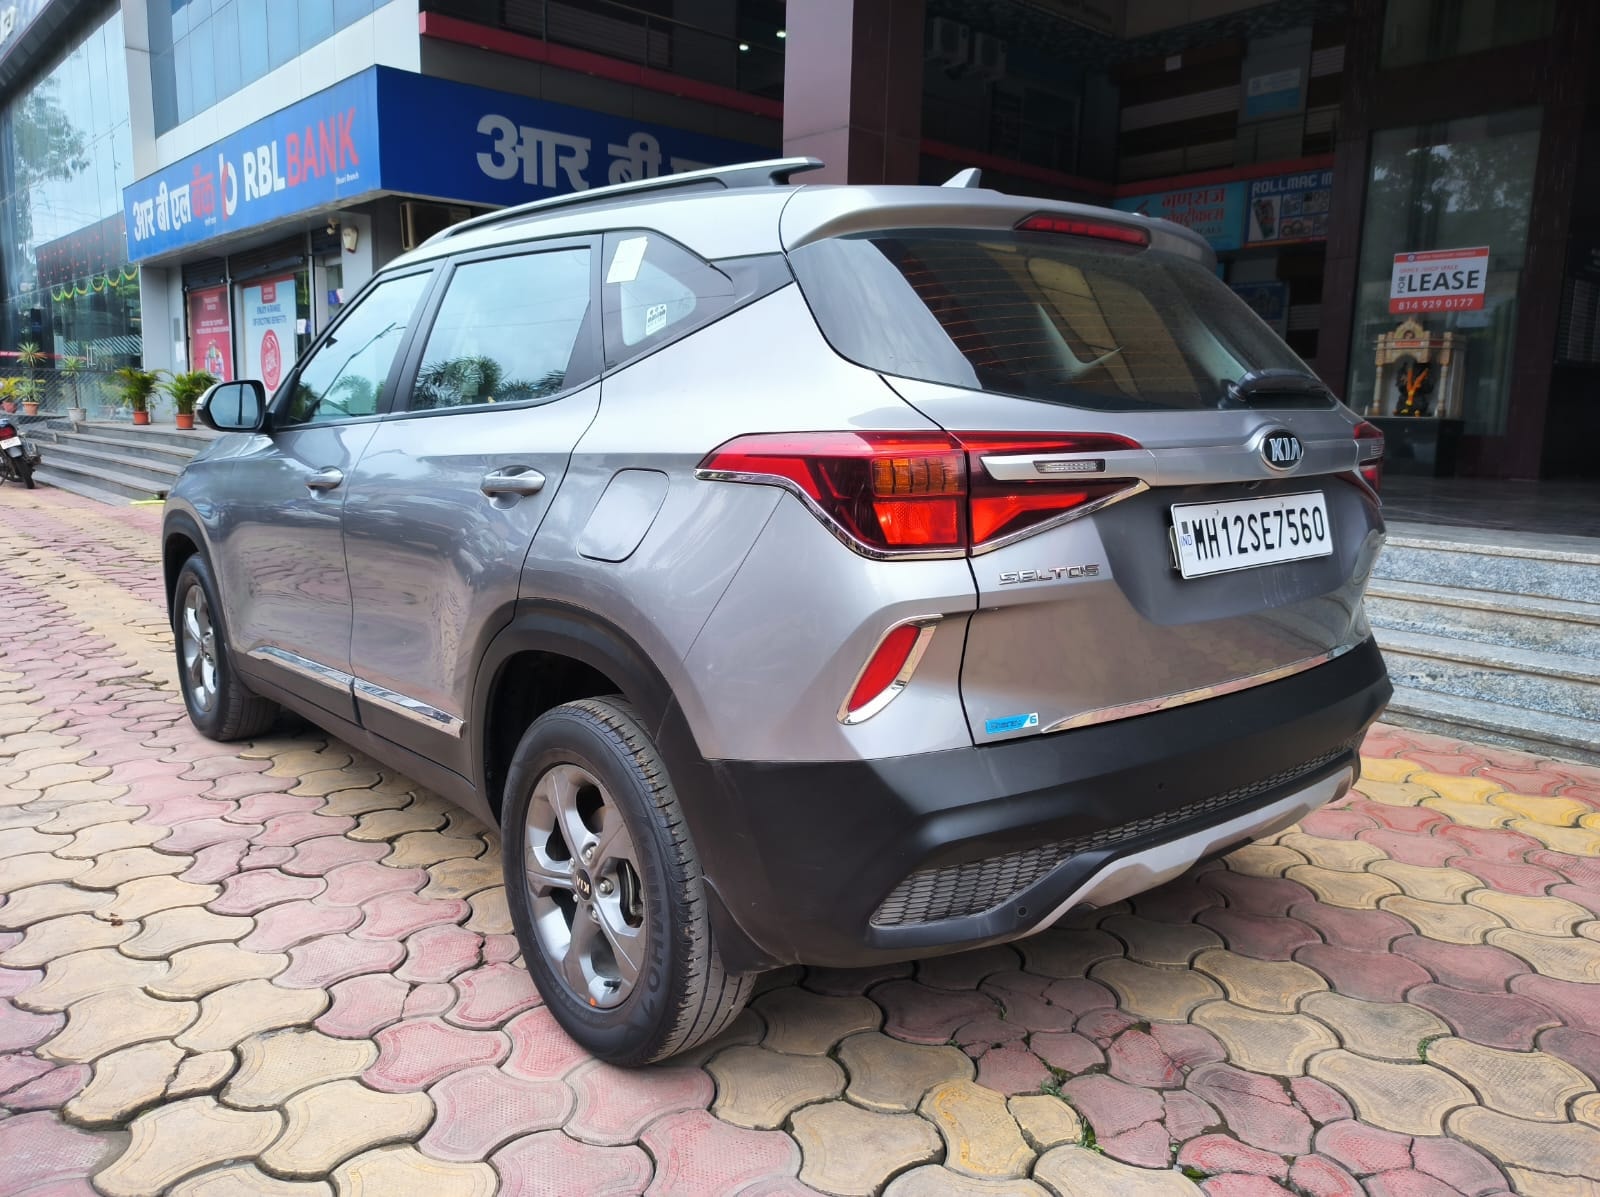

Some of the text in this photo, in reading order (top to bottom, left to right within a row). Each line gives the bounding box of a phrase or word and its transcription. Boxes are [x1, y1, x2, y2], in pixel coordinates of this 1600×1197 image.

[243, 107, 358, 202] RBL BANK
[476, 114, 591, 190] आर
[1251, 174, 1318, 199] ROLLMAC
[132, 198, 156, 242] आर
[155, 181, 170, 232] बी
[169, 184, 192, 231] एल
[1397, 275, 1406, 294] FOR
[1407, 270, 1479, 292] LEASE
[1398, 297, 1474, 311] 814 929 0177
[1269, 437, 1301, 462] KIA
[1179, 534, 1193, 547] IND
[1192, 505, 1325, 561] MH12SE7560
[999, 563, 1100, 586] SELTOS
[1029, 714, 1037, 724] 6
[576, 874, 590, 895] KIA
